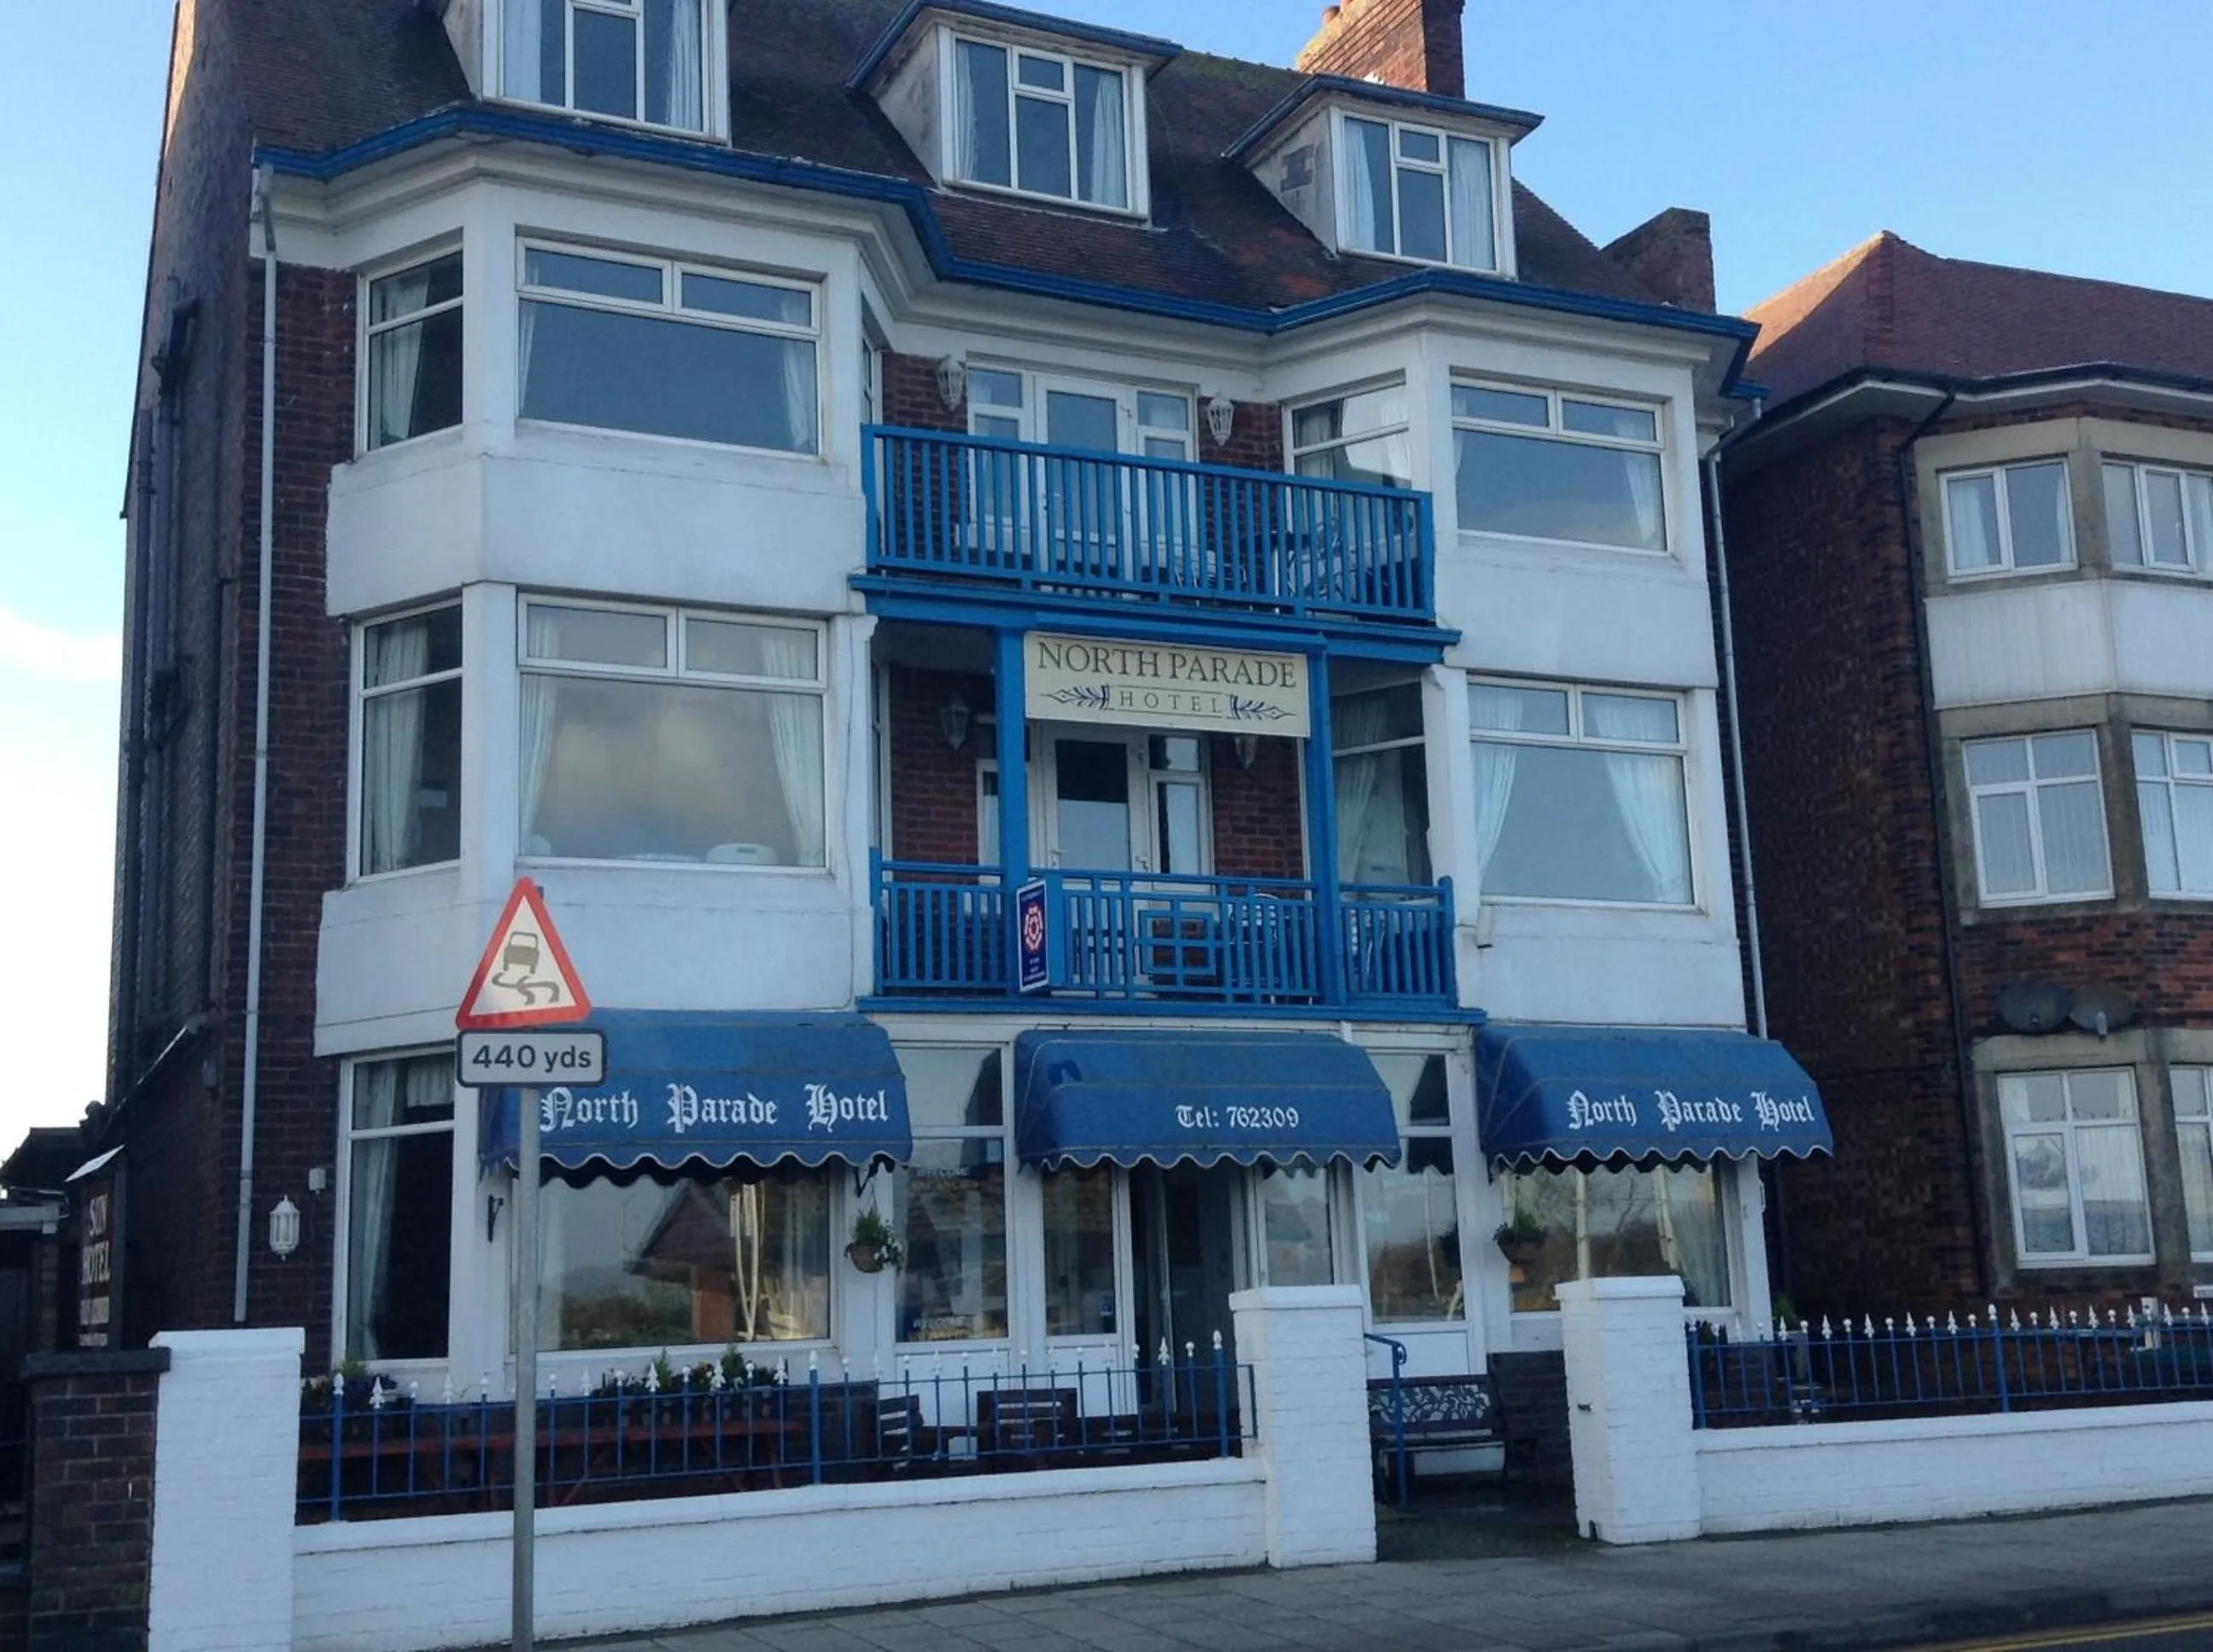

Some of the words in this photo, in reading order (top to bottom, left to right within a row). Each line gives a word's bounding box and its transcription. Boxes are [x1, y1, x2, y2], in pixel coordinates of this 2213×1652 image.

[1038, 641, 1161, 679] NORTH
[1168, 652, 1298, 688] PARADE
[1120, 691, 1223, 713] HOTEL
[471, 1044, 536, 1069] 440
[545, 1045, 592, 1073] yds
[539, 1086, 639, 1133] North
[666, 1083, 777, 1134] Parade
[804, 1083, 889, 1134] Hotel
[1176, 1105, 1220, 1129] Tel:
[1226, 1106, 1299, 1129] 762309
[1566, 1089, 1637, 1130] North
[1655, 1089, 1743, 1131] Parade
[1750, 1090, 1815, 1132] Hotel
[82, 1240, 109, 1285] HOTEL
